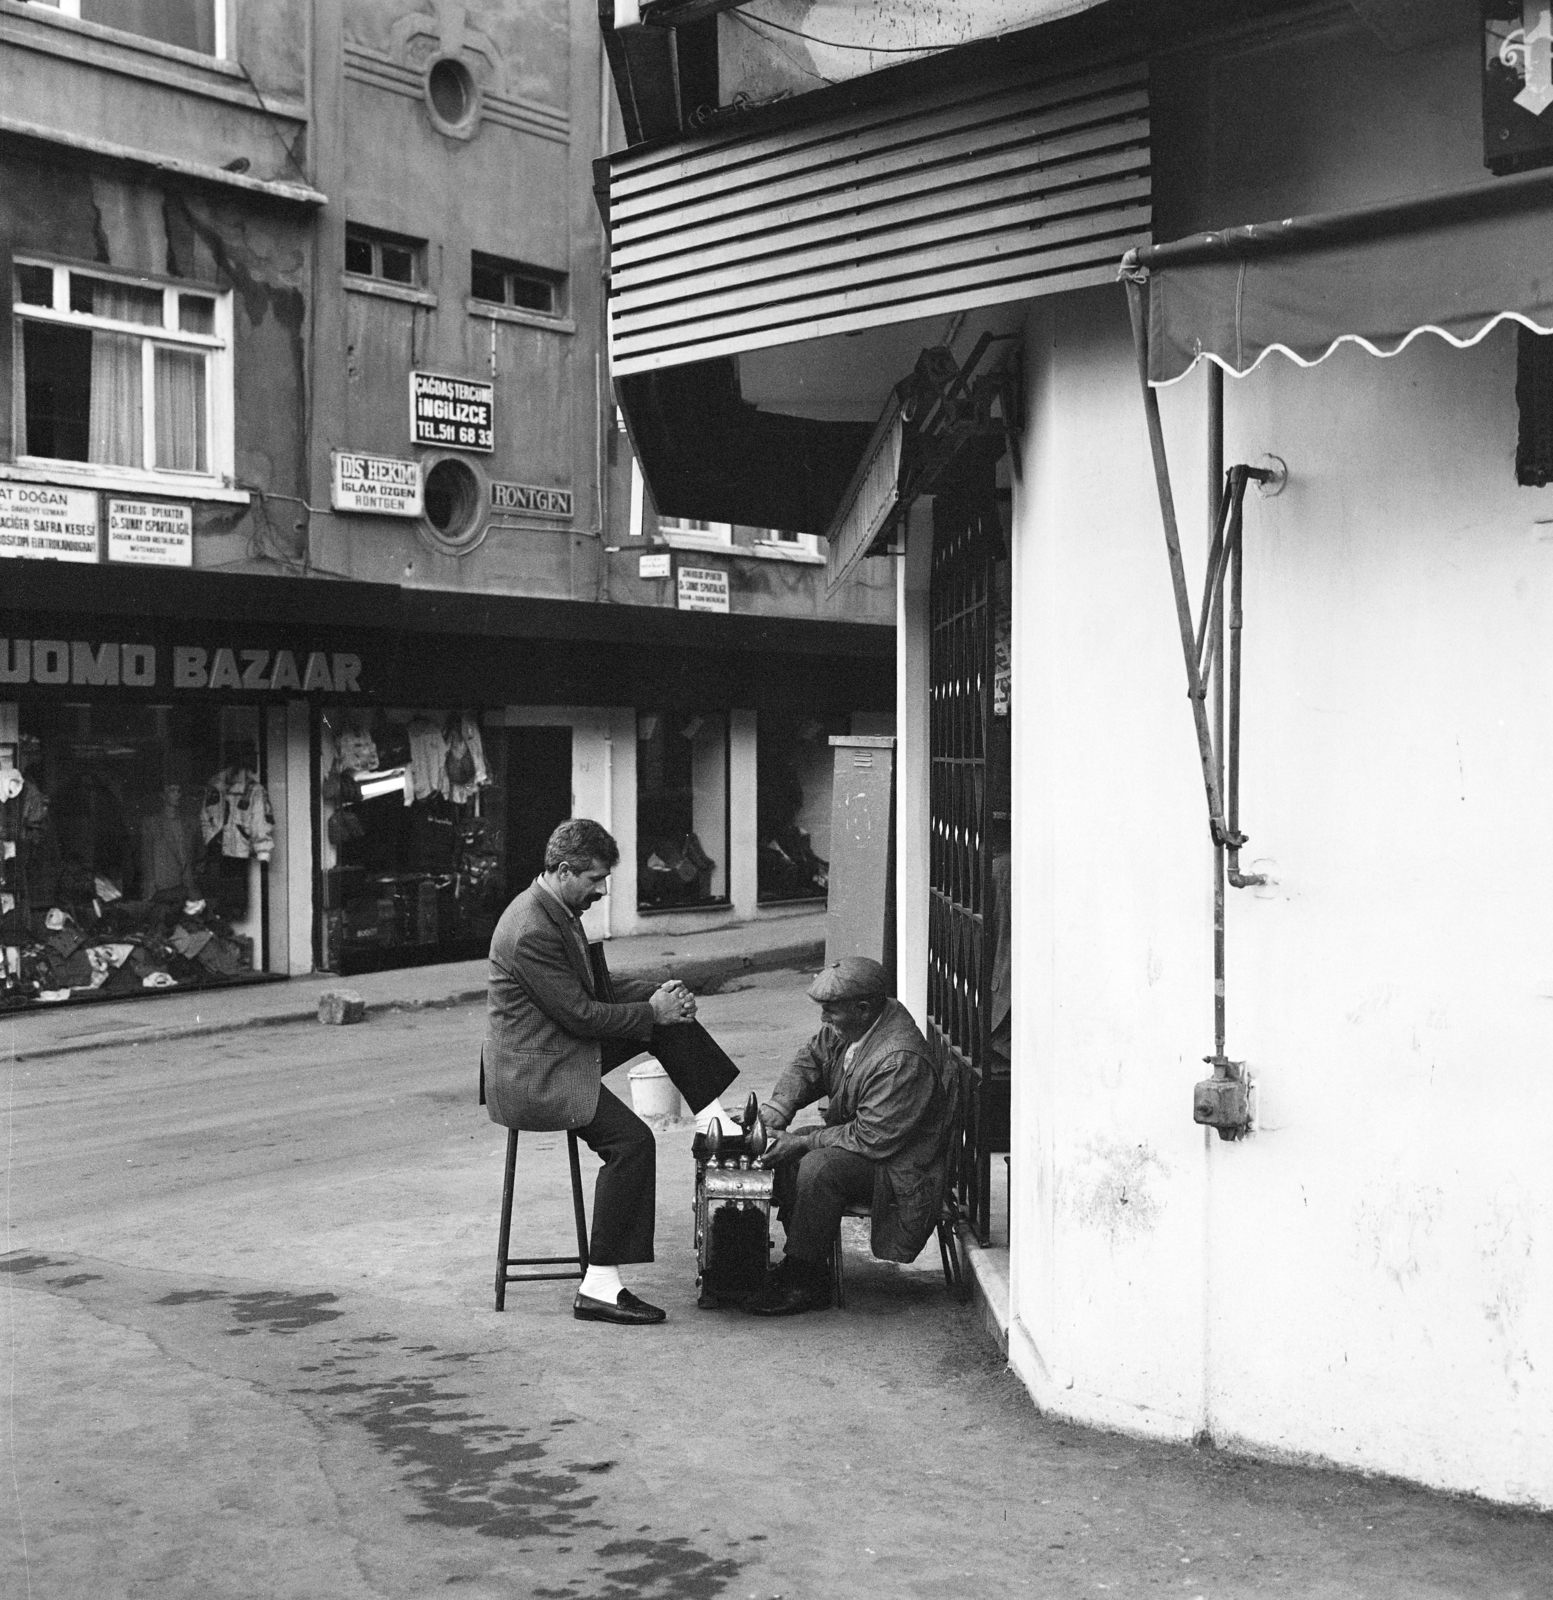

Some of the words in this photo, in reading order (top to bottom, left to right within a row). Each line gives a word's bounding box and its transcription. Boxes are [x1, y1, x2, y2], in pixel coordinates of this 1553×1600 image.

[418, 397, 487, 425] İNGİLİZCE
[459, 427, 476, 444] 68
[478, 429, 492, 446] 33
[380, 484, 416, 499] ÖZGEN
[34, 519, 63, 533] SAFRA
[173, 646, 362, 692] BAZAAR
